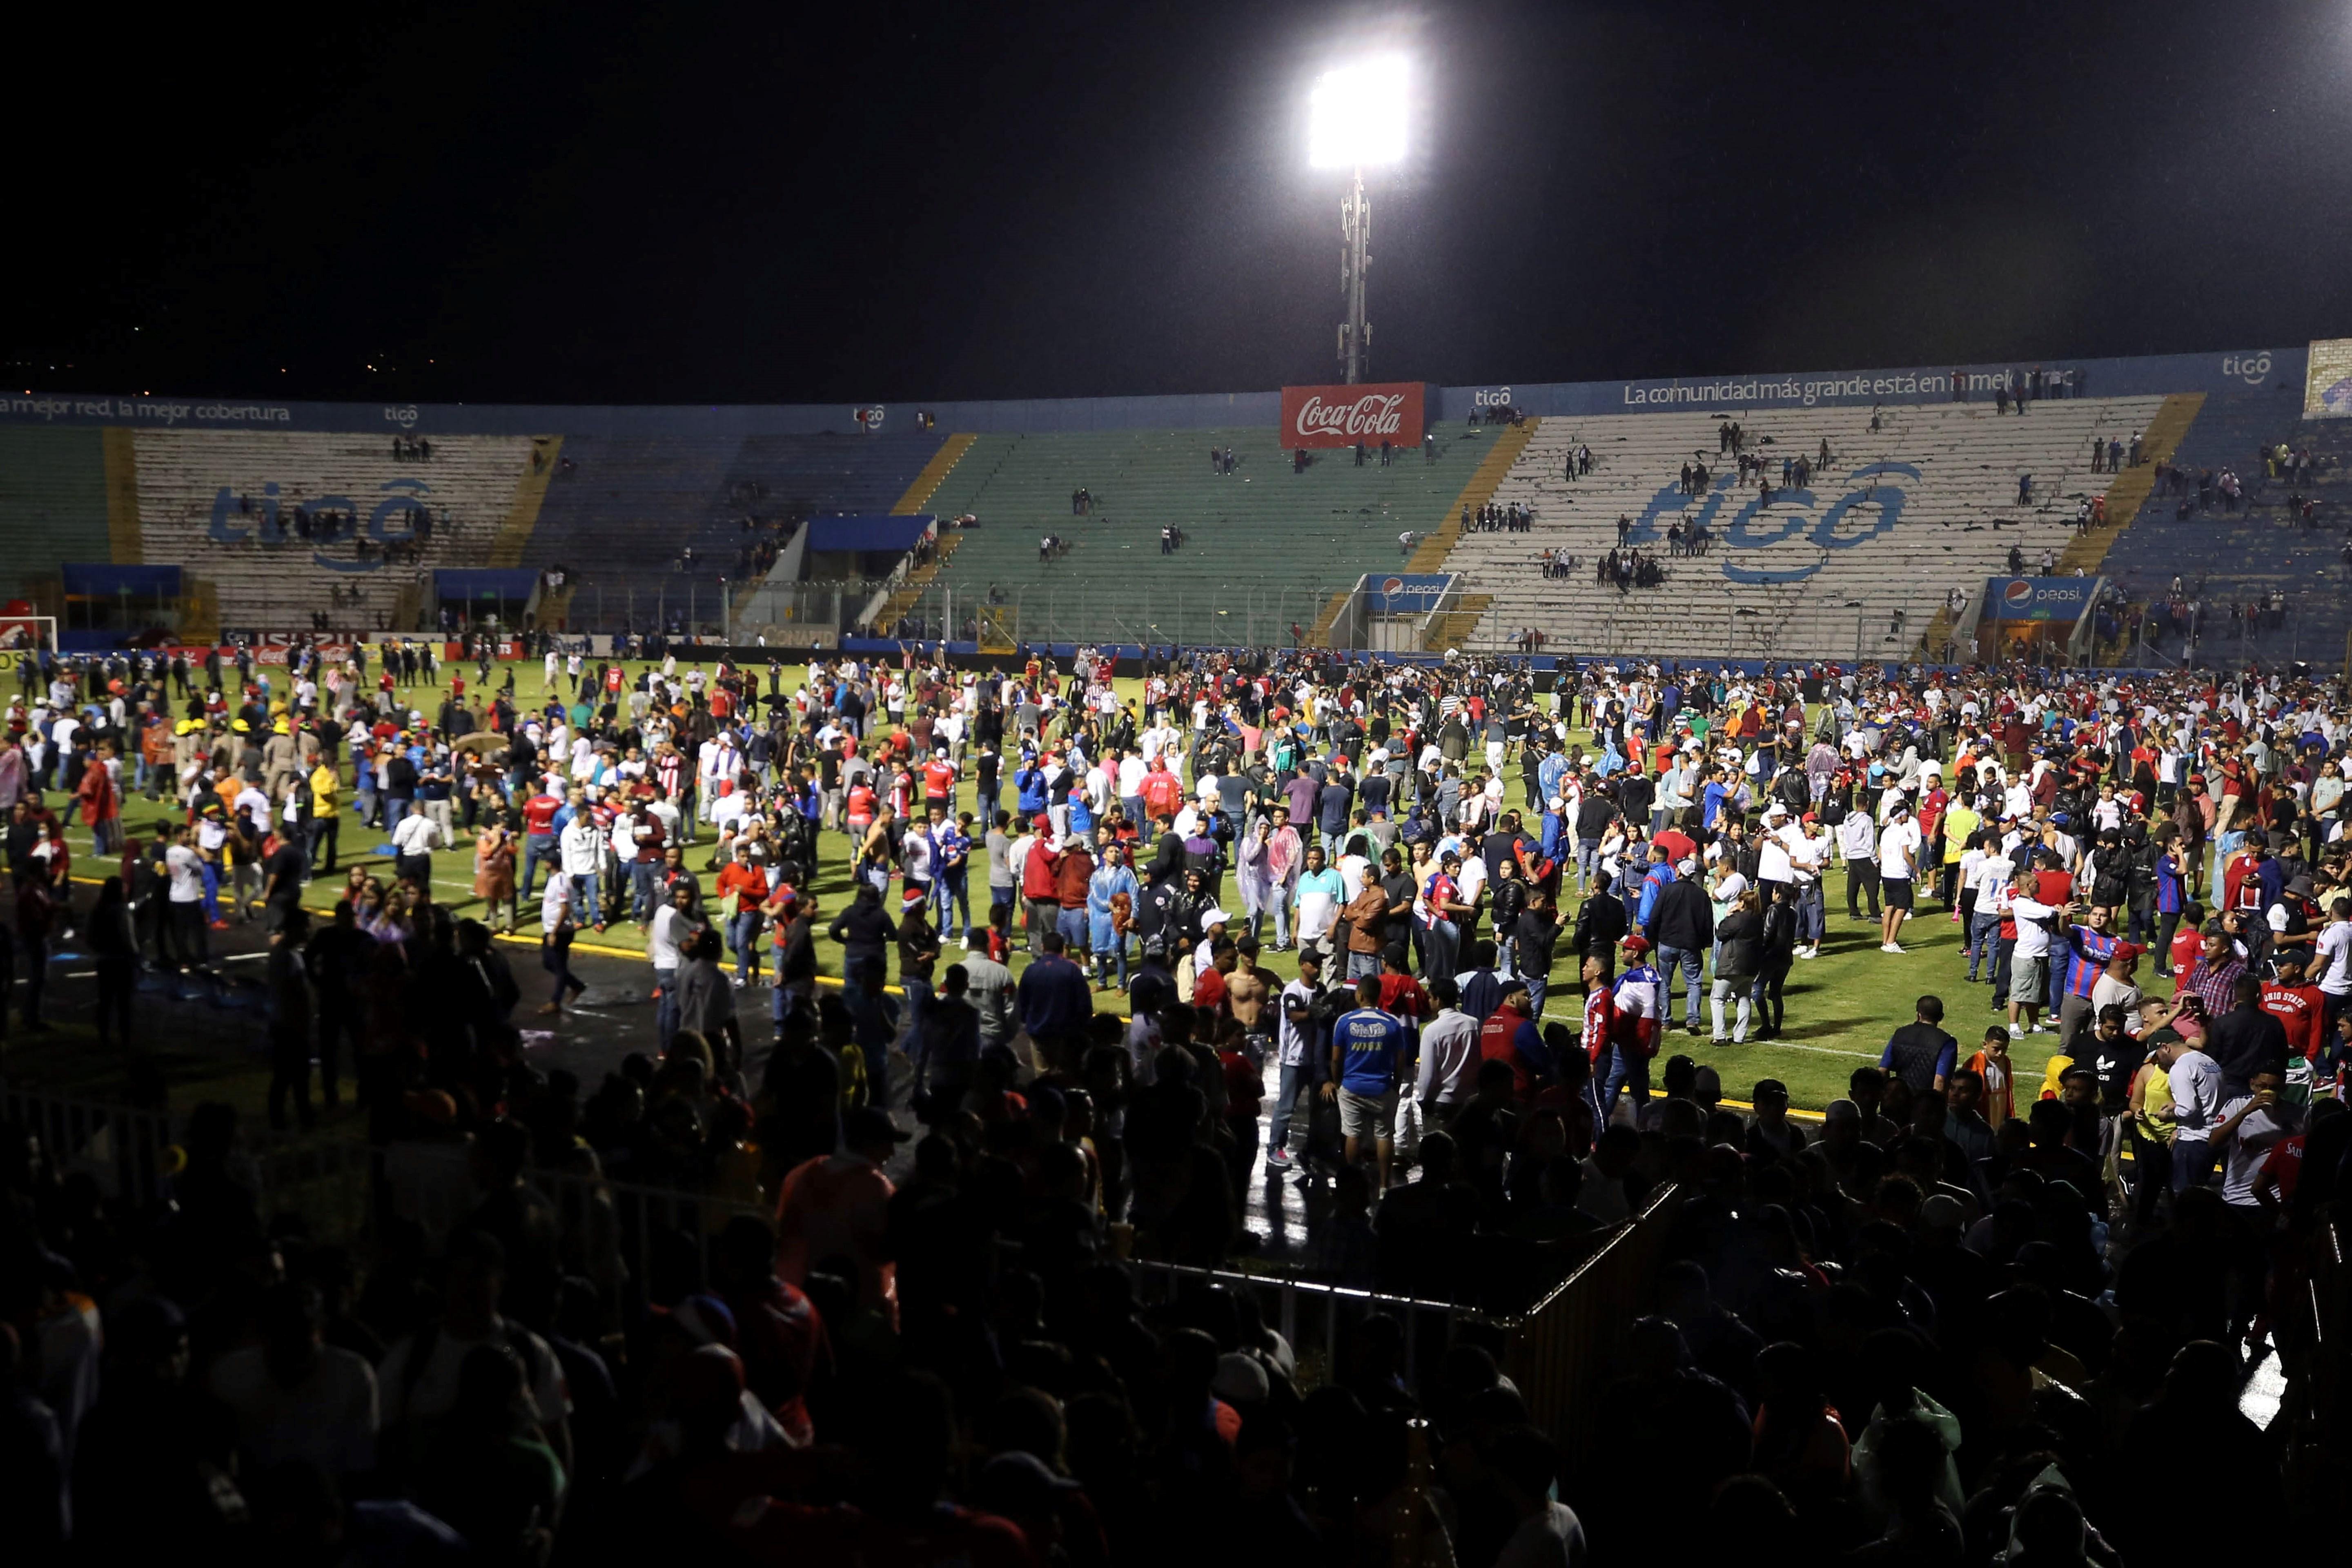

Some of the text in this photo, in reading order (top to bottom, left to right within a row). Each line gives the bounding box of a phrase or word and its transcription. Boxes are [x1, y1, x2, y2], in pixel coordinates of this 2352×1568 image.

[2223, 351, 2271, 385] tigo
[1475, 387, 1510, 406] tigo
[1625, 385, 1646, 404] La
[1649, 381, 1758, 403] comunidad
[1760, 378, 1800, 399] más
[1803, 375, 1872, 405] grande
[1874, 372, 1916, 395] está
[1920, 377, 1945, 393] en
[12, 399, 71, 421] mejor
[76, 399, 114, 417] red,
[118, 401, 134, 416] la
[138, 402, 192, 425] mejor
[196, 405, 290, 421] cobertura
[853, 405, 884, 429] tgo
[1296, 394, 1405, 436] Coca-Cola
[1406, 583, 1440, 595] pepsi
[2036, 587, 2080, 603] pepsi
[2263, 991, 2281, 1002] OHIO
[2283, 992, 2307, 1008] STATE
